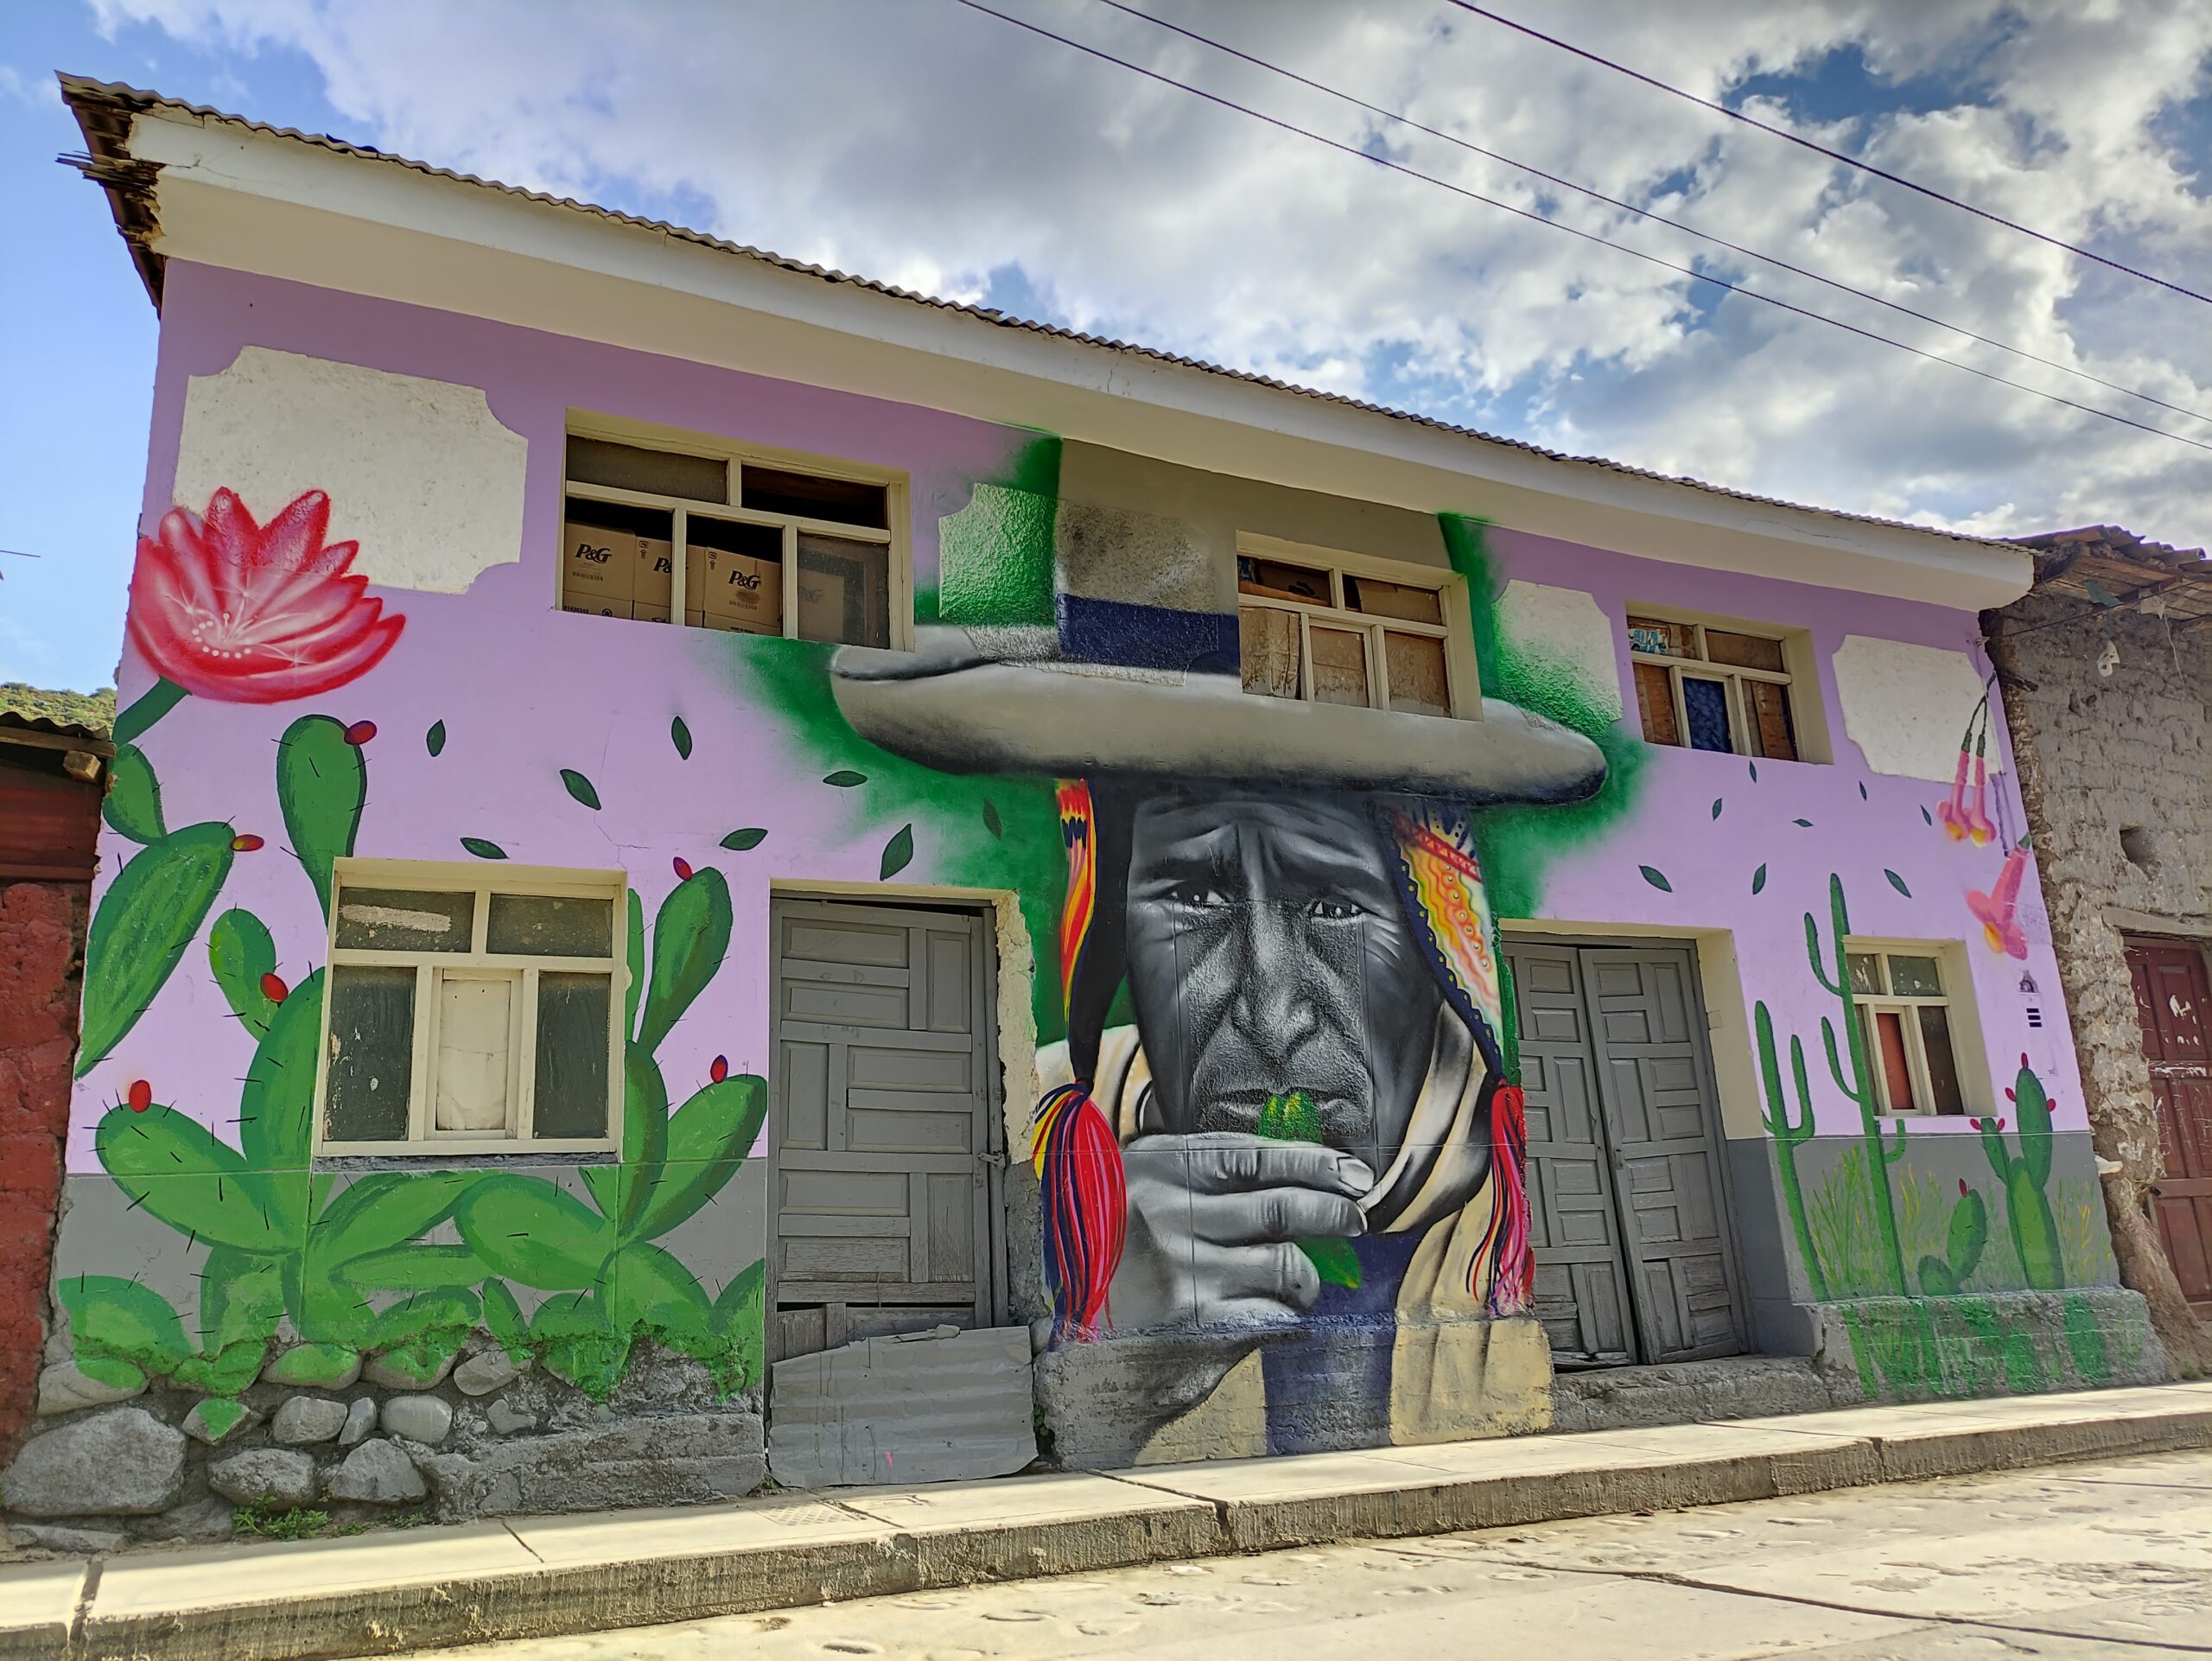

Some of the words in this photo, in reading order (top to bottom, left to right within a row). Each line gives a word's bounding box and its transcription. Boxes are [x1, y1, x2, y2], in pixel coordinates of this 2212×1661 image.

[575, 544, 612, 563] P&G
[653, 557, 671, 574] P&
[728, 570, 760, 590] P&G
